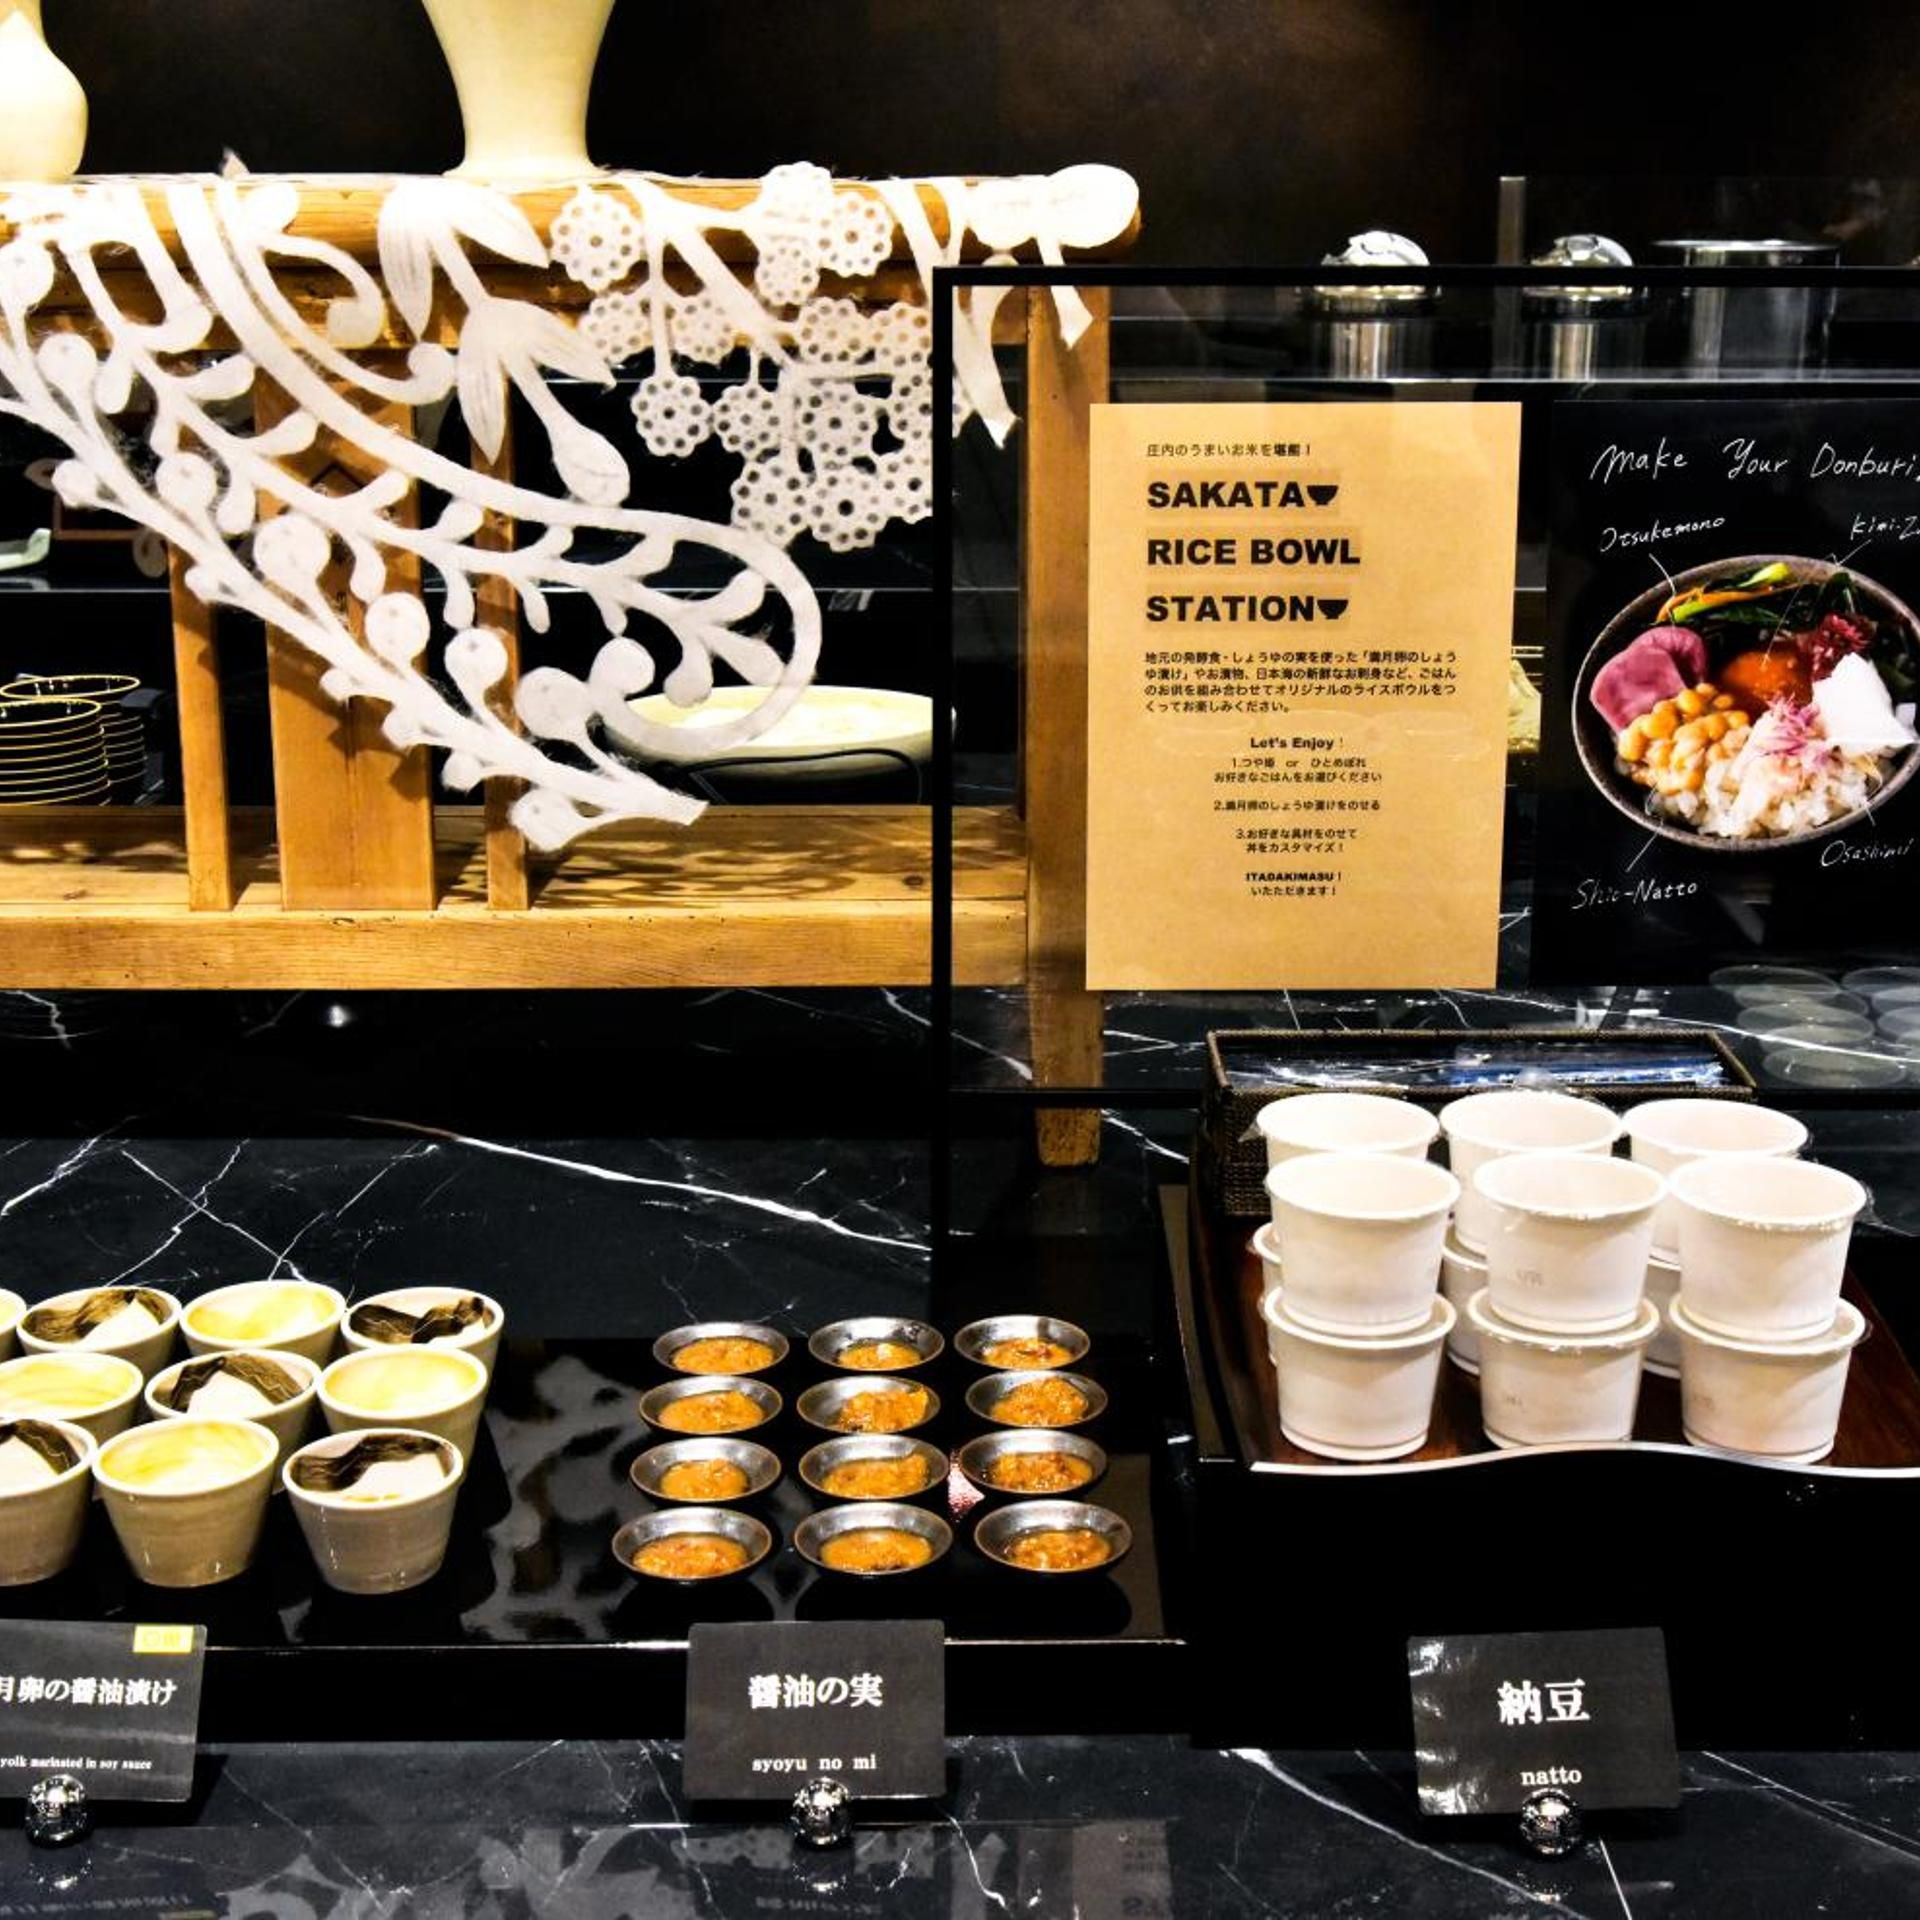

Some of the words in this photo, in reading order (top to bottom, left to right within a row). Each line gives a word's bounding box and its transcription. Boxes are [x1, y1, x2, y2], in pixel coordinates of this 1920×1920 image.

[1589, 436, 1688, 484] Make
[1722, 438, 1789, 480] Your
[1147, 481, 1305, 508] SAKATA
[1849, 511, 1920, 541] Kimi-Z
[1147, 539, 1237, 566] RICE
[1250, 538, 1361, 565] BOWL
[1146, 595, 1315, 622] STATION
[1250, 737, 1287, 748] Let's
[1285, 760, 1299, 768] or
[748, 1672, 884, 1709] 醤油の実
[1497, 1678, 1591, 1725] 納豆
[30, 1757, 83, 1769] marinated
[86, 1758, 96, 1769] in
[99, 1760, 118, 1770] soy
[122, 1760, 152, 1770] sauce
[752, 1757, 808, 1773] syoyu
[819, 1757, 842, 1770] no
[852, 1753, 877, 1770] mi
[1520, 1766, 1582, 1786] natto
